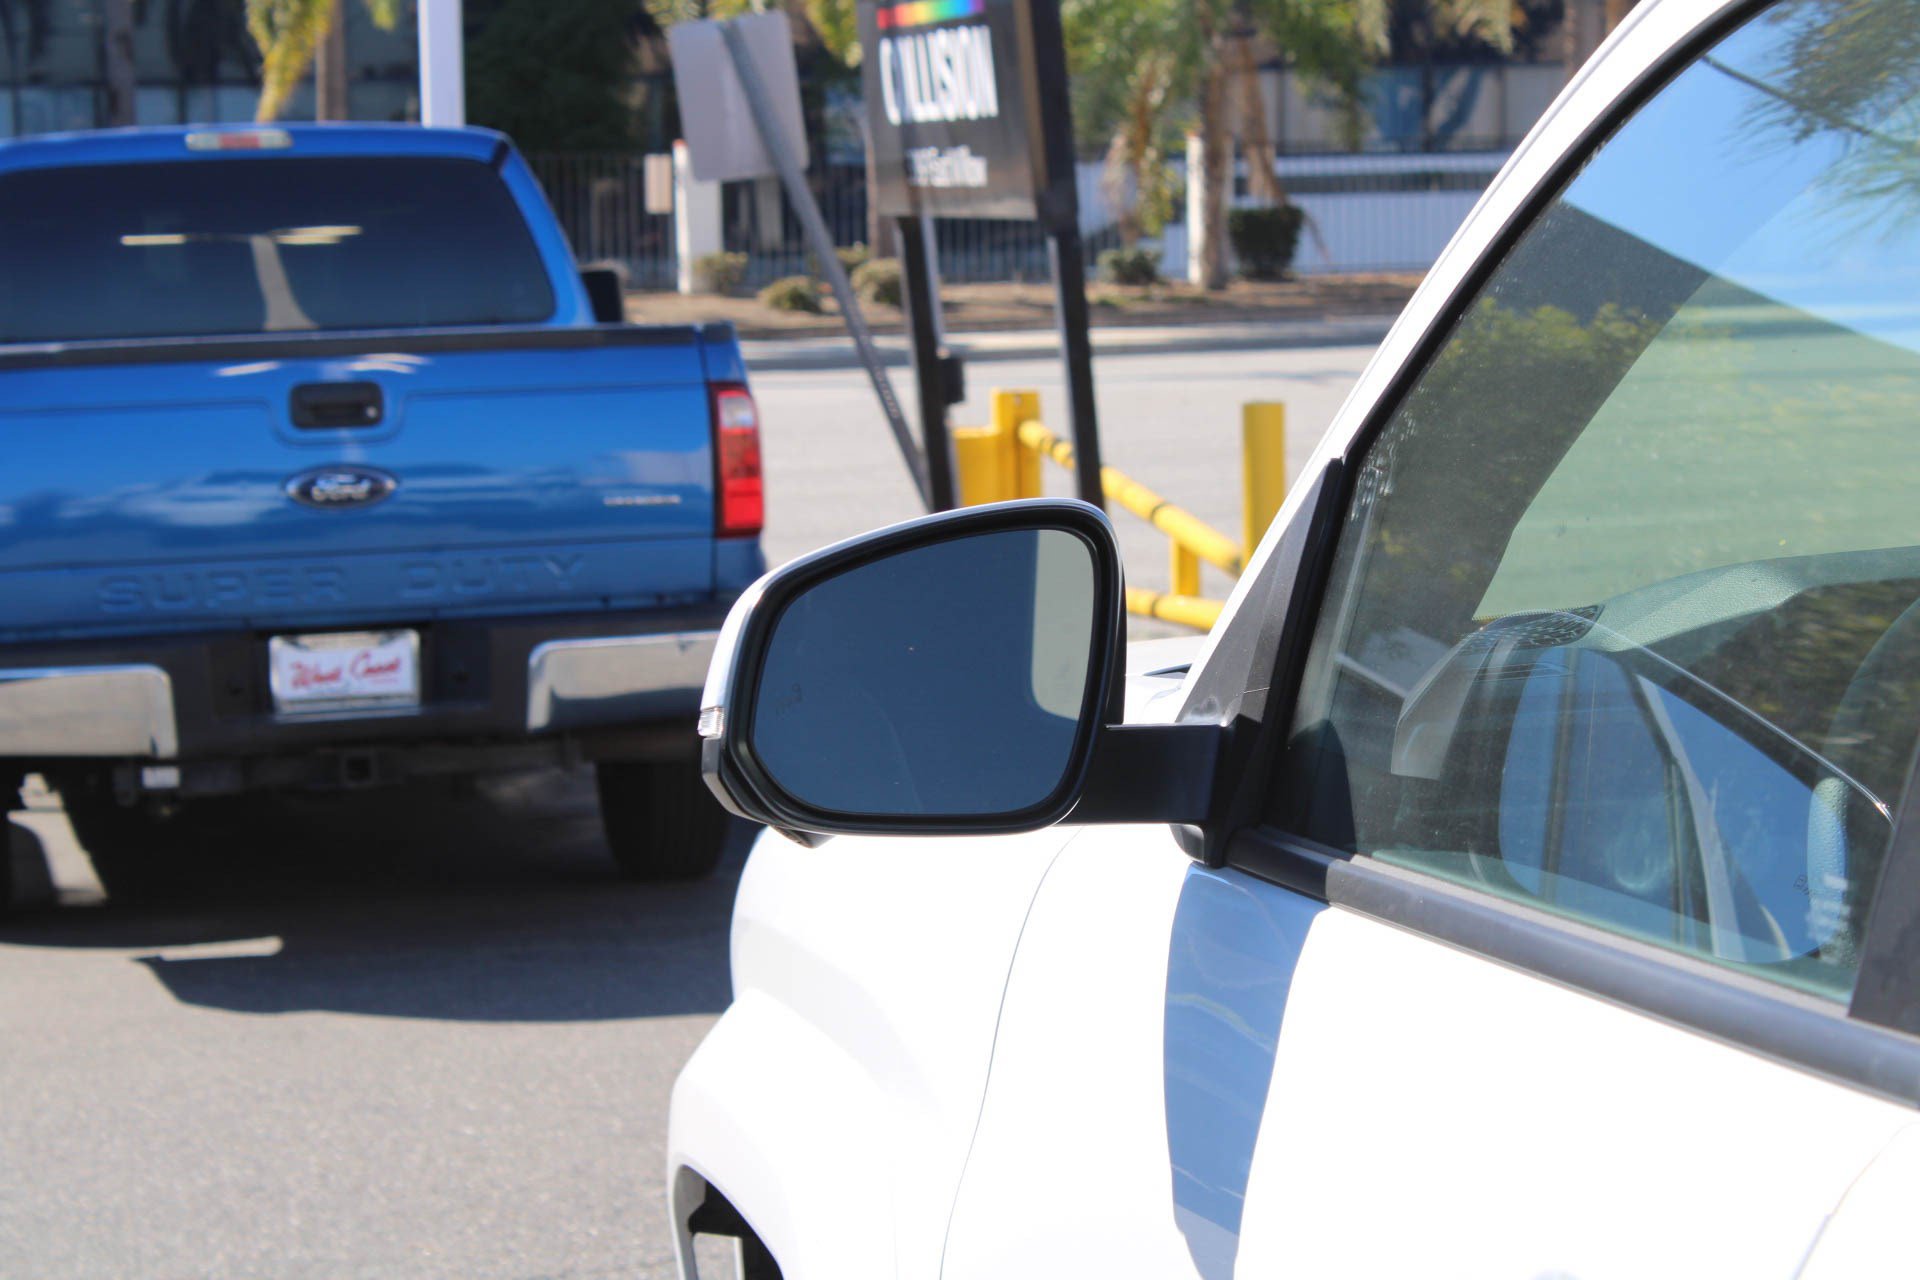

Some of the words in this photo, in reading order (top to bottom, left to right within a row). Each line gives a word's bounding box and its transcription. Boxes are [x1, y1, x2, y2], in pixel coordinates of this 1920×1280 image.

[312, 473, 371, 502] Ford
[99, 565, 346, 613] SUPER
[399, 553, 584, 598] DUTY
